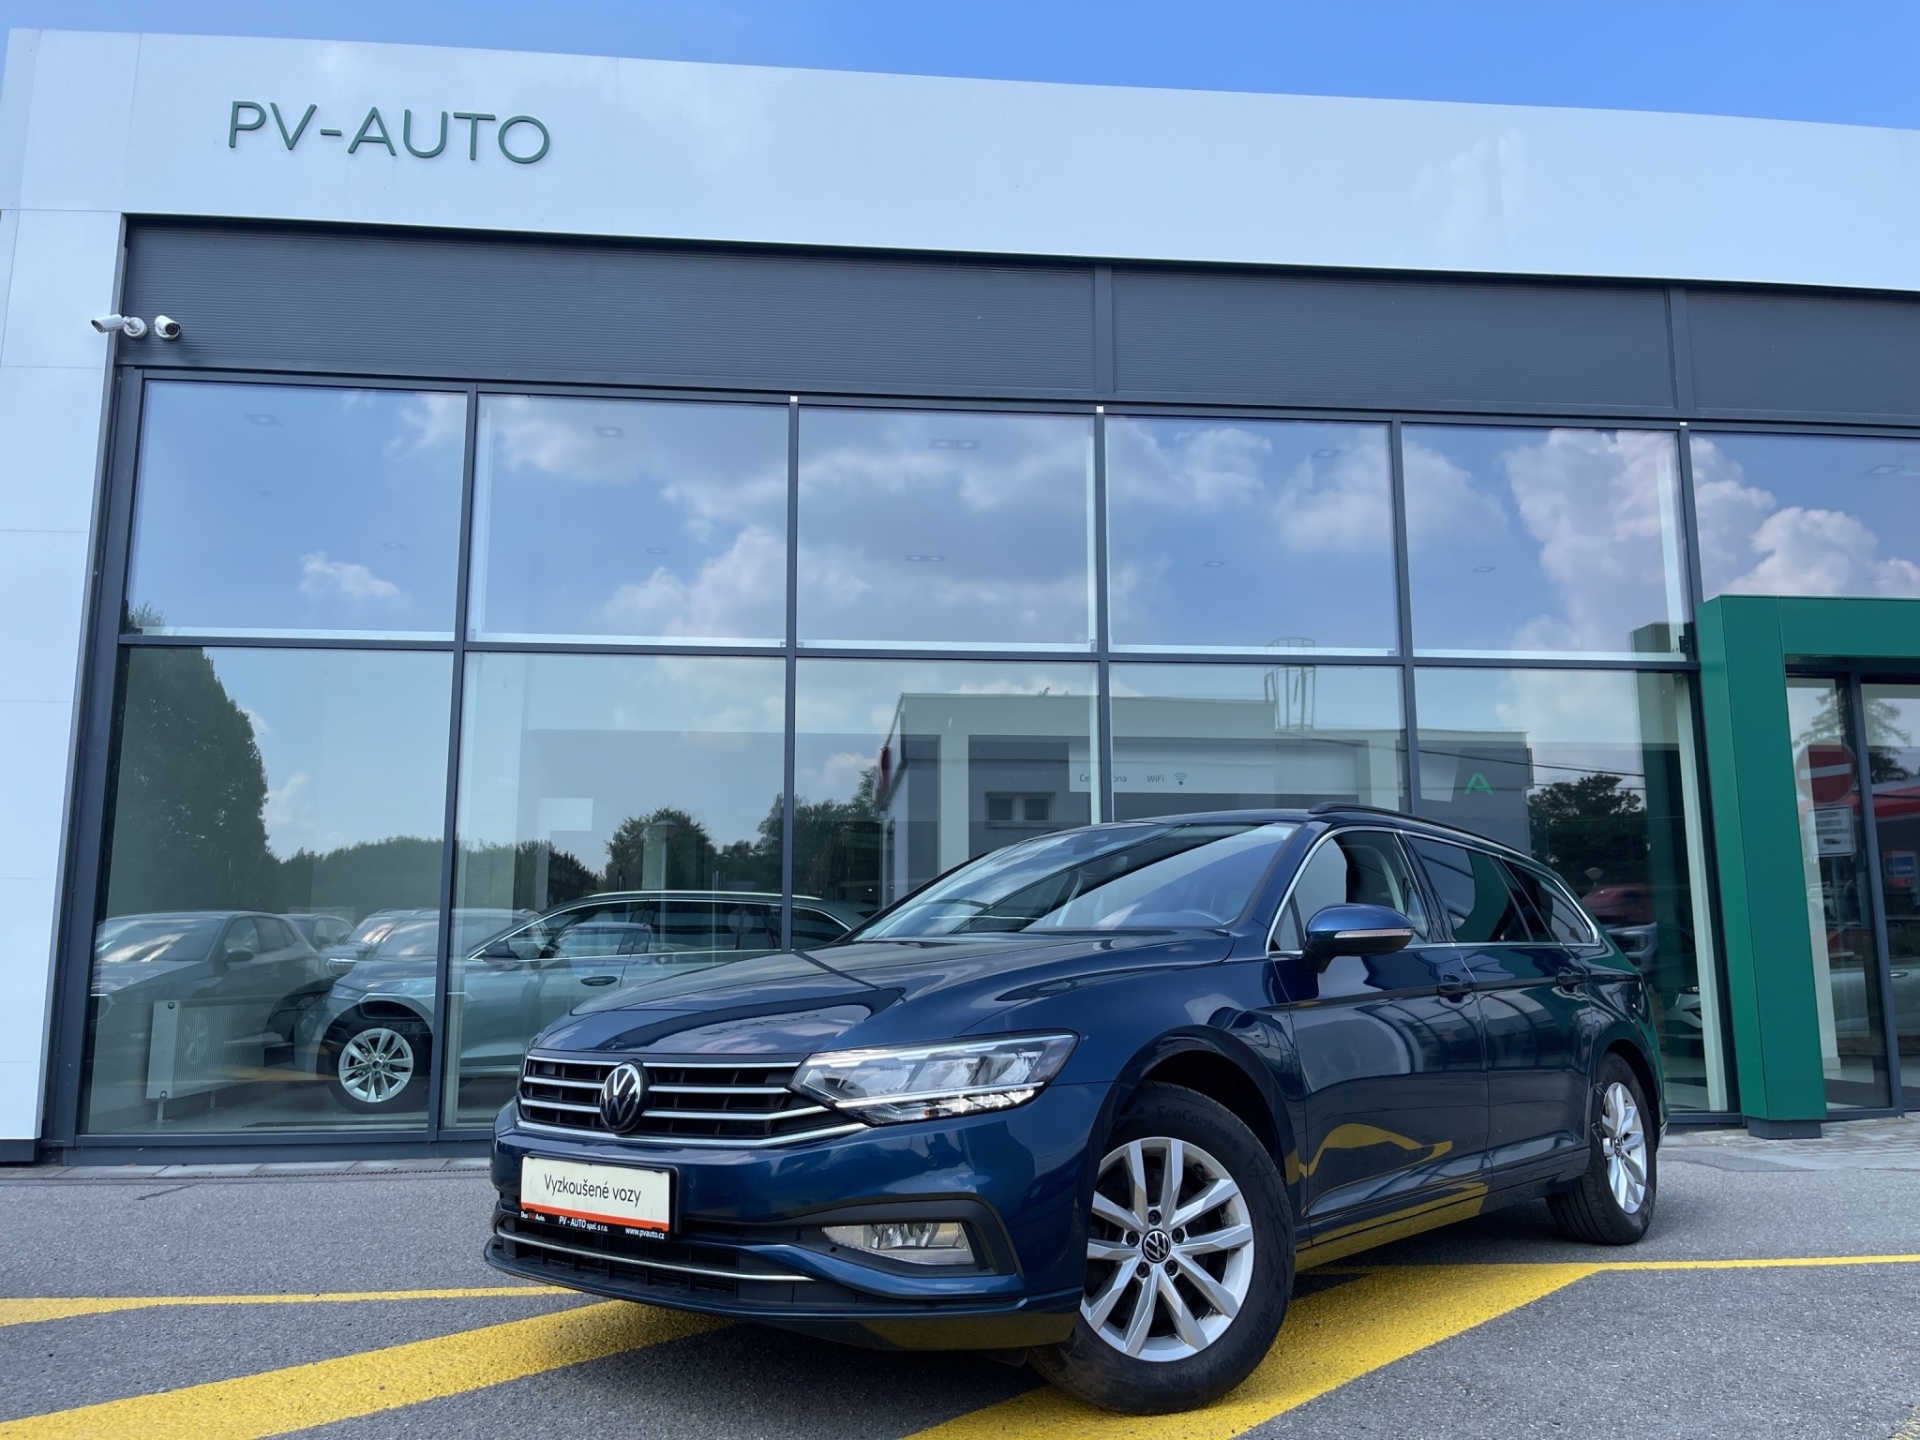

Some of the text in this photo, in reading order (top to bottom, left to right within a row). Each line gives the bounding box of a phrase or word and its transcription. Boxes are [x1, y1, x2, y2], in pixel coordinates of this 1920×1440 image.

[228, 100, 550, 164] PV-AUTO
[1146, 774, 1165, 783] WiFi
[544, 1173, 642, 1208] Vyzkoušené vozy
[558, 1215, 568, 1225] PV
[570, 1217, 587, 1229] AUTO
[625, 1227, 665, 1240] www.pvauto.cz
